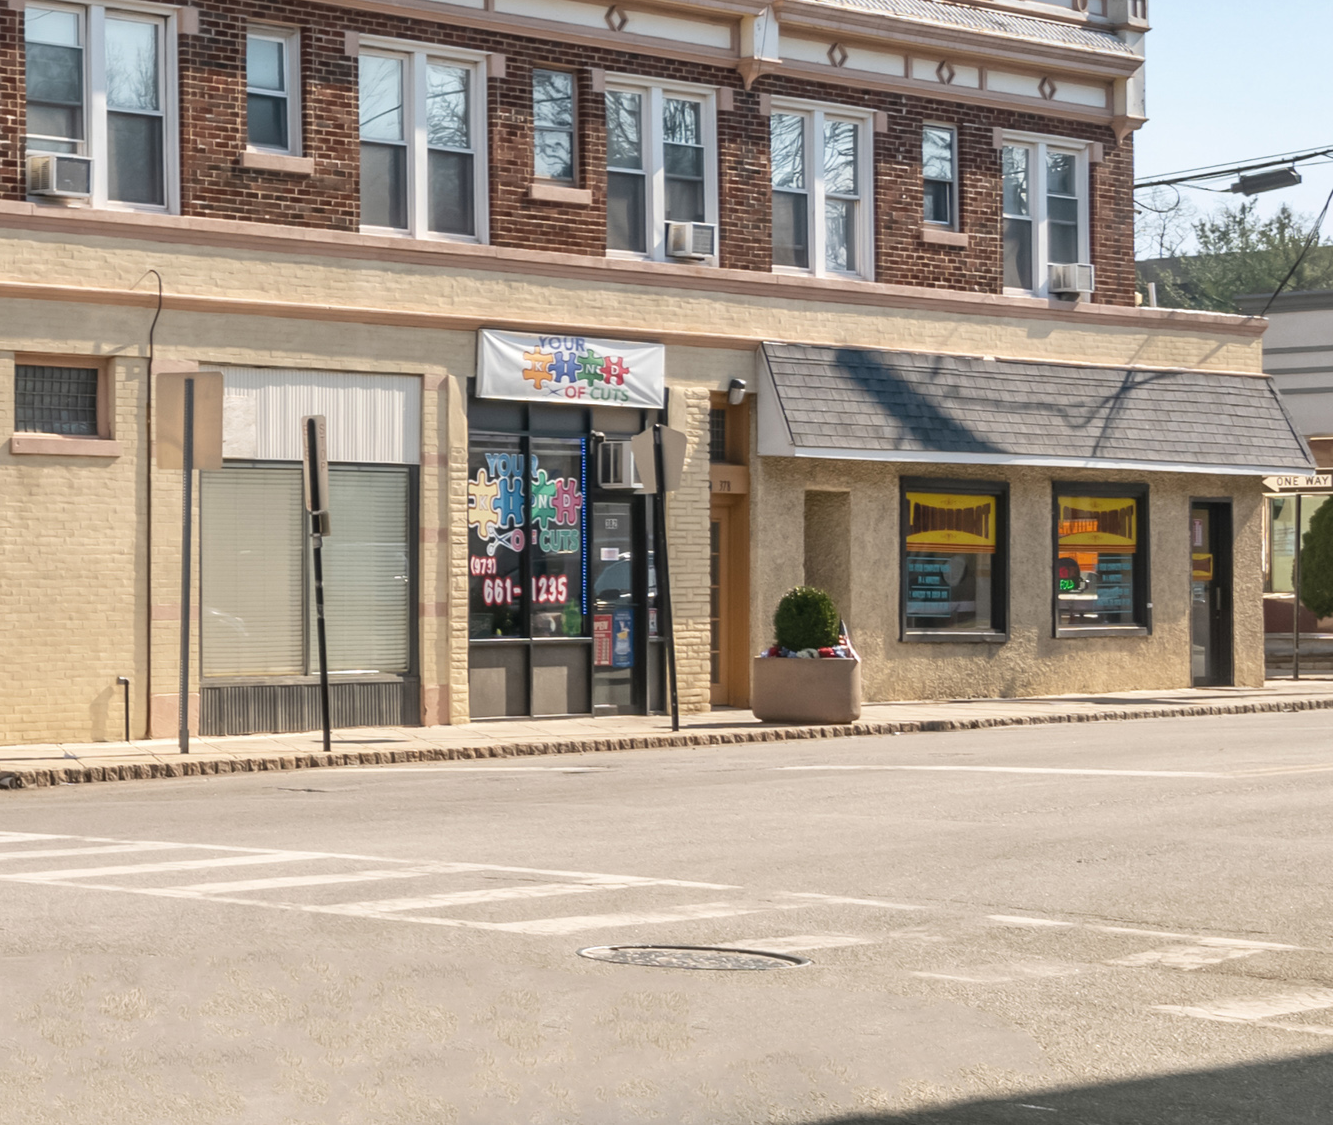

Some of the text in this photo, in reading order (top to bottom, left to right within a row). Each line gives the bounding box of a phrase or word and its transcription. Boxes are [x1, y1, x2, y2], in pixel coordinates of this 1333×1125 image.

[538, 336, 586, 352] YOUR
[535, 361, 620, 375] KIND
[564, 386, 630, 402] OF CUTS
[318, 423, 327, 472] STOP
[1276, 475, 1329, 486] ONE WAY
[479, 494, 571, 511] KIND
[539, 528, 580, 553] CUTS
[471, 556, 496, 575] (973)
